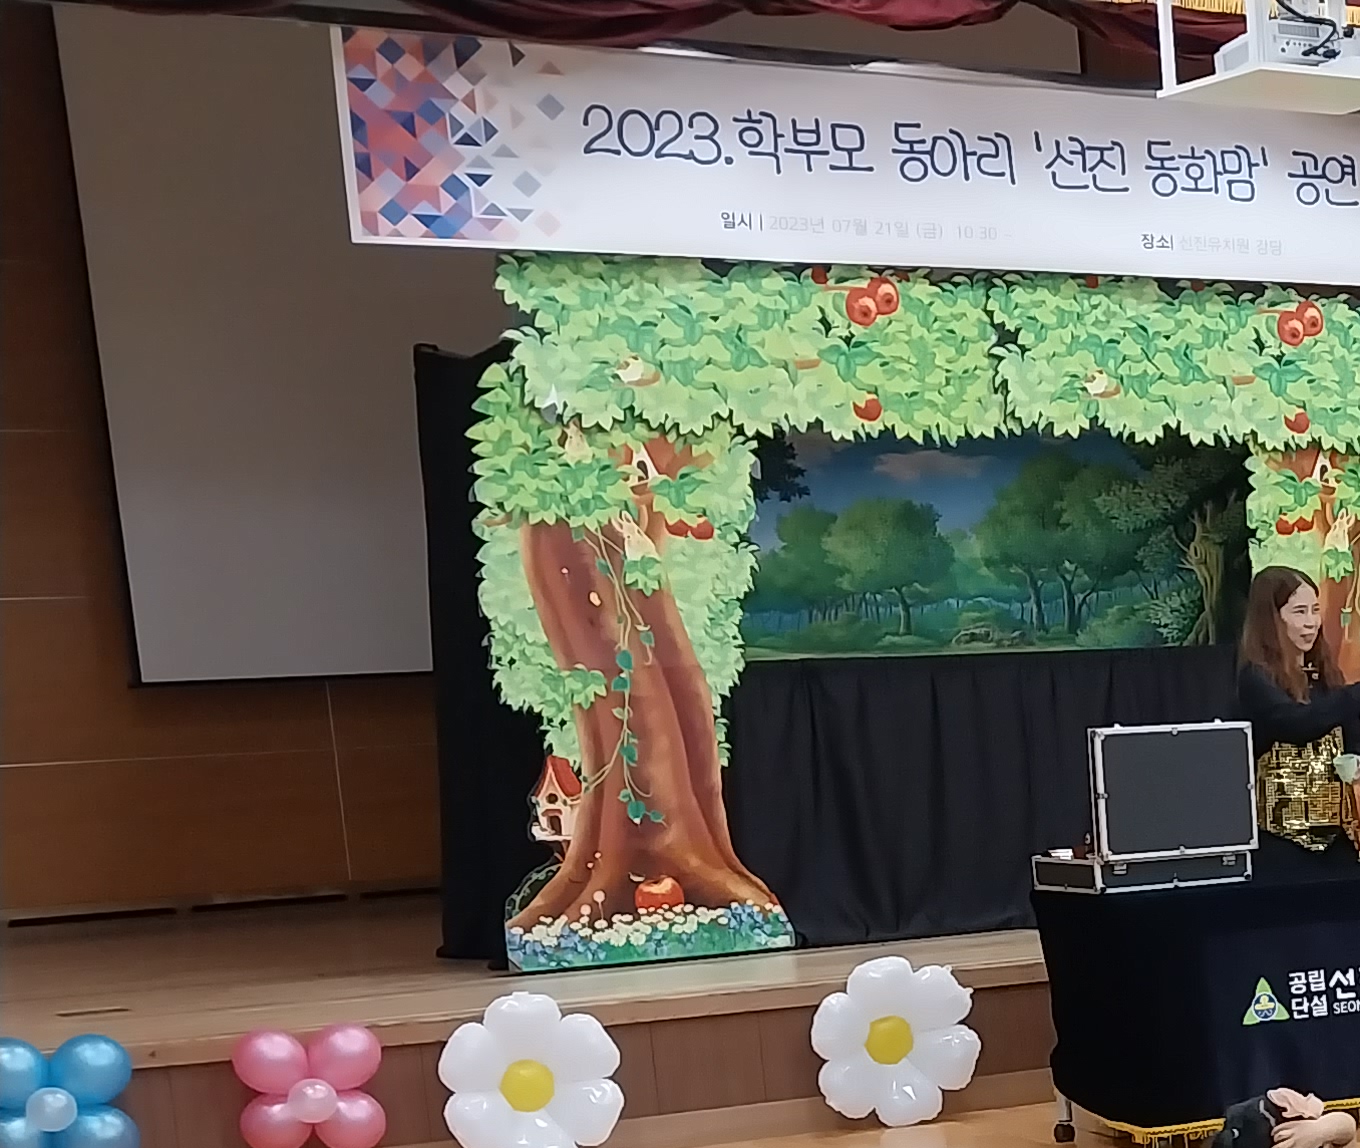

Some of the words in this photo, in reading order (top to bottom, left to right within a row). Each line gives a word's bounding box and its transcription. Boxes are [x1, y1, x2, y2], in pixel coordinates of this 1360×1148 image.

[582, 103, 875, 175] 2023.학부모
[891, 122, 1018, 186] 동아리
[1287, 150, 1360, 207] 공연
[1288, 969, 1327, 995] 공립
[1290, 994, 1329, 1019] 단설
